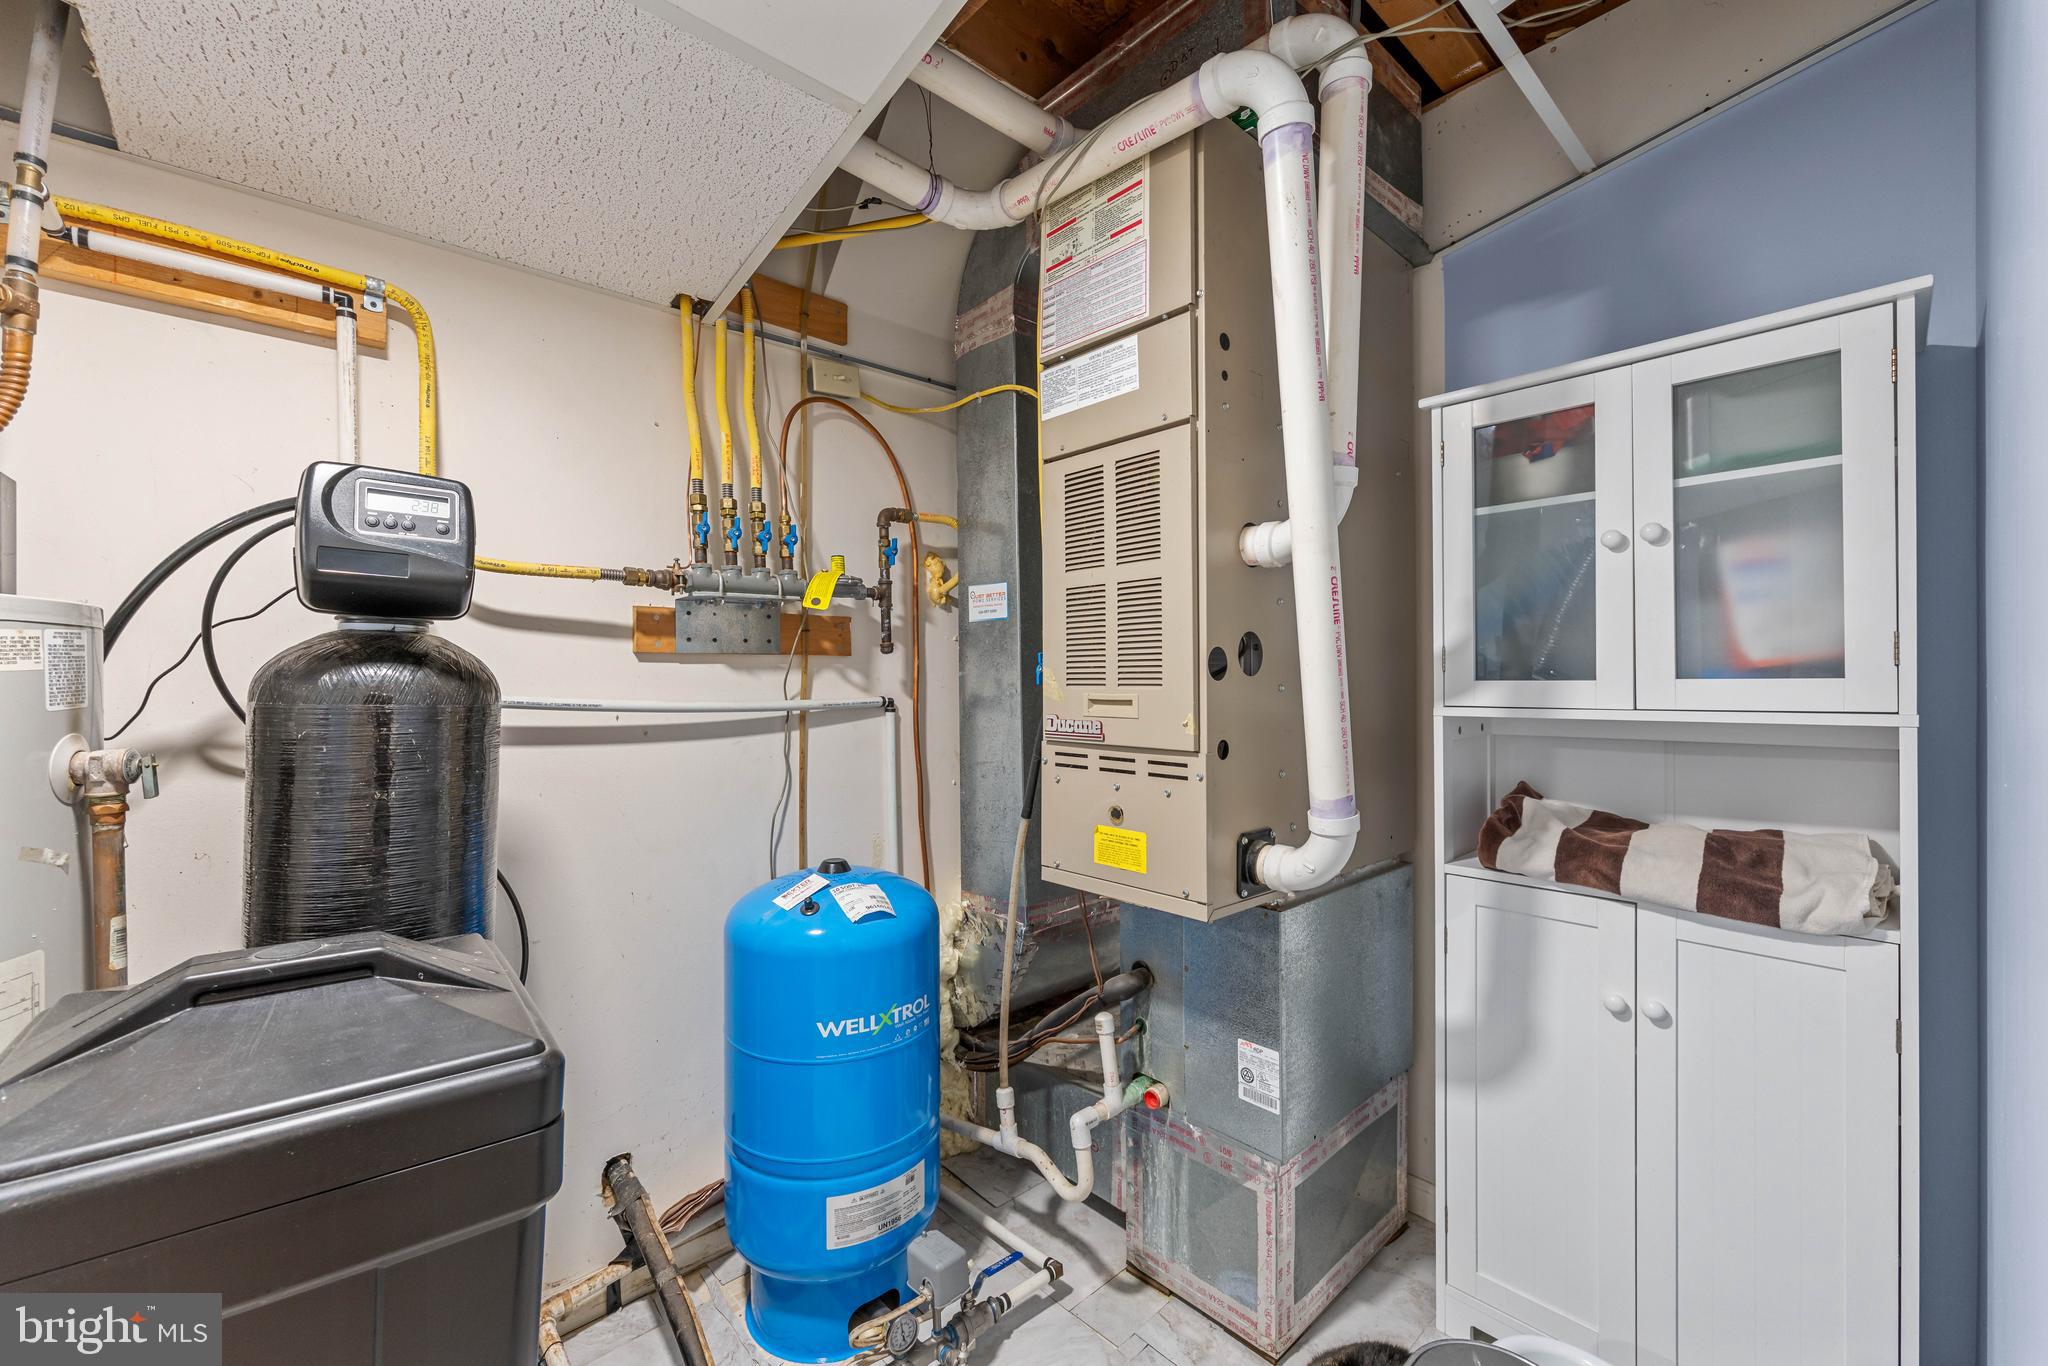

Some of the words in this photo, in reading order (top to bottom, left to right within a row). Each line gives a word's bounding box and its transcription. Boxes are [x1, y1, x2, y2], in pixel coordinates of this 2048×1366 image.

[1117, 125, 1157, 152] CRESLINE
[112, 212, 131, 224] GAS
[135, 217, 158, 230] FUEL
[162, 225, 180, 236] PSI
[411, 500, 439, 514] 2:38
[1330, 576, 1341, 625] CRESLINE
[1046, 714, 1103, 735] Ducane
[816, 994, 930, 1038] WELLXTROL
[878, 1214, 902, 1231] UN1956
